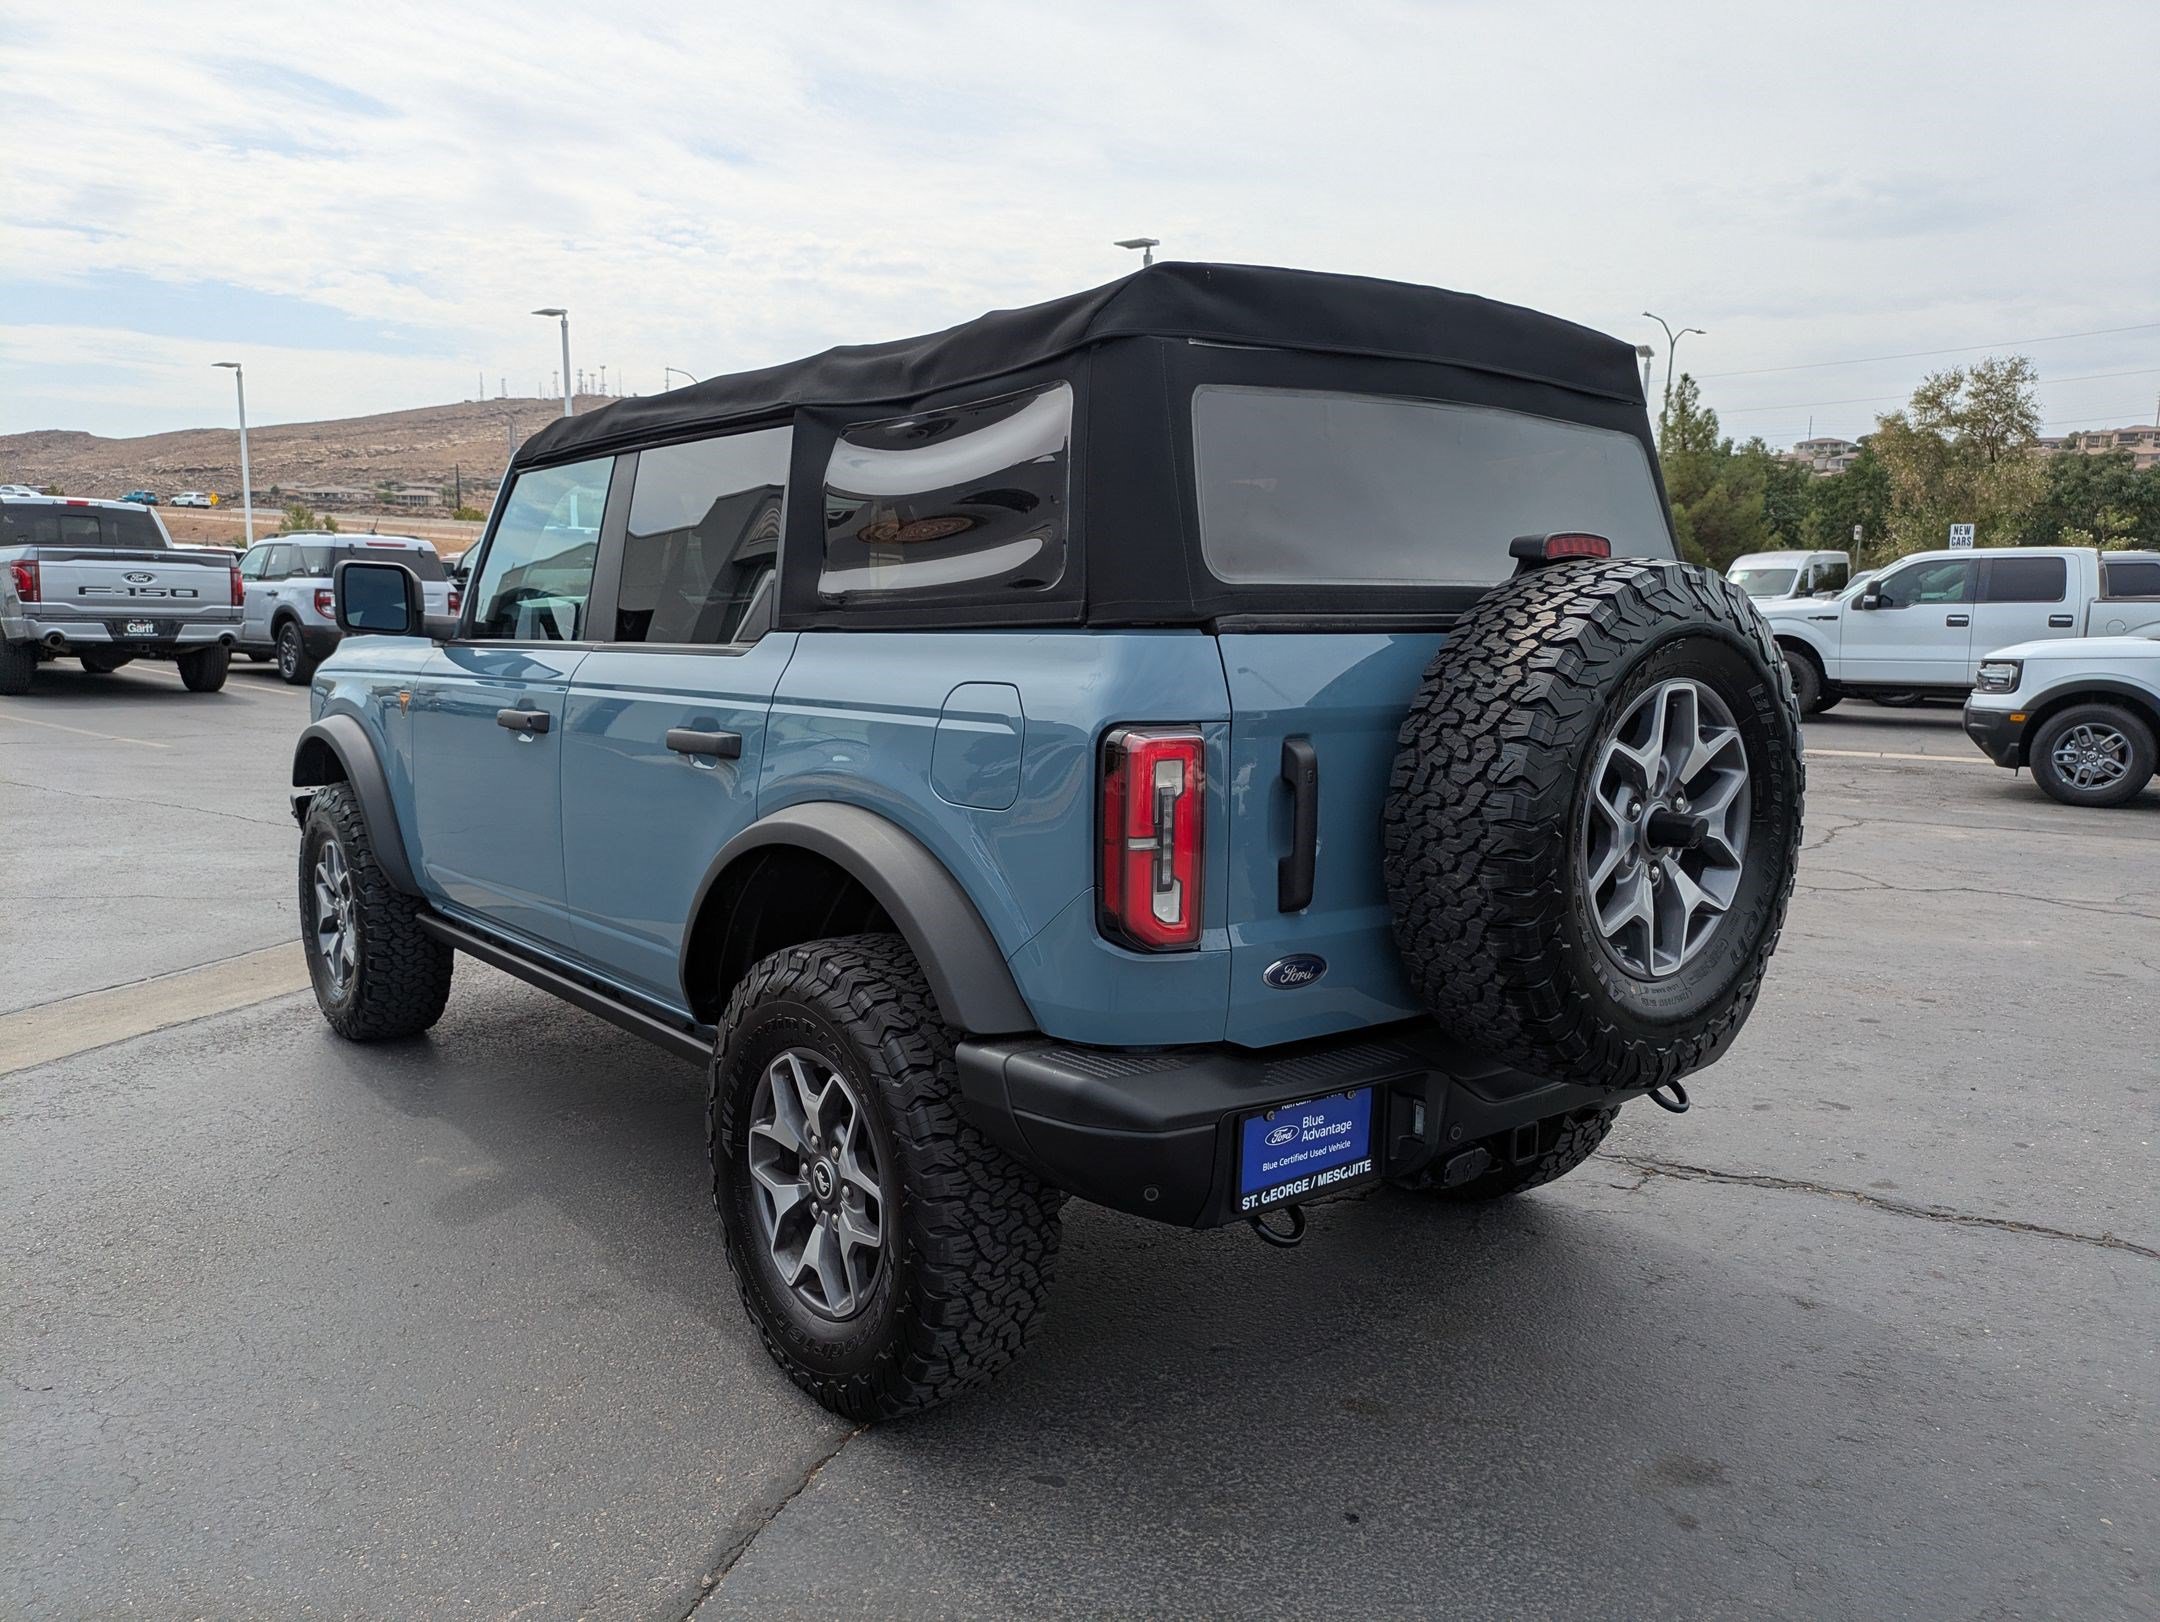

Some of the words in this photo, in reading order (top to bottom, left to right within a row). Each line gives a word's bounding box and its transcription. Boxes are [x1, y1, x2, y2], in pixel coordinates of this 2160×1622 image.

[1953, 525, 1971, 536] NEW
[1951, 536, 1972, 547] CARS
[78, 586, 199, 598] F-150
[127, 623, 153, 633] Garff
[1280, 963, 1315, 984] Ford
[1302, 1115, 1325, 1129] Blue
[1271, 1128, 1294, 1144] Ford
[1301, 1120, 1353, 1143] Advantage
[1262, 1161, 1278, 1172] Blue
[1279, 1150, 1309, 1167] Certified
[1309, 1145, 1328, 1158] Used
[1328, 1139, 1352, 1153] Vehicle
[1241, 1194, 1259, 1210] ST.
[1261, 1178, 1310, 1204] GEORGE
[1317, 1159, 1373, 1187] MESQUITE
